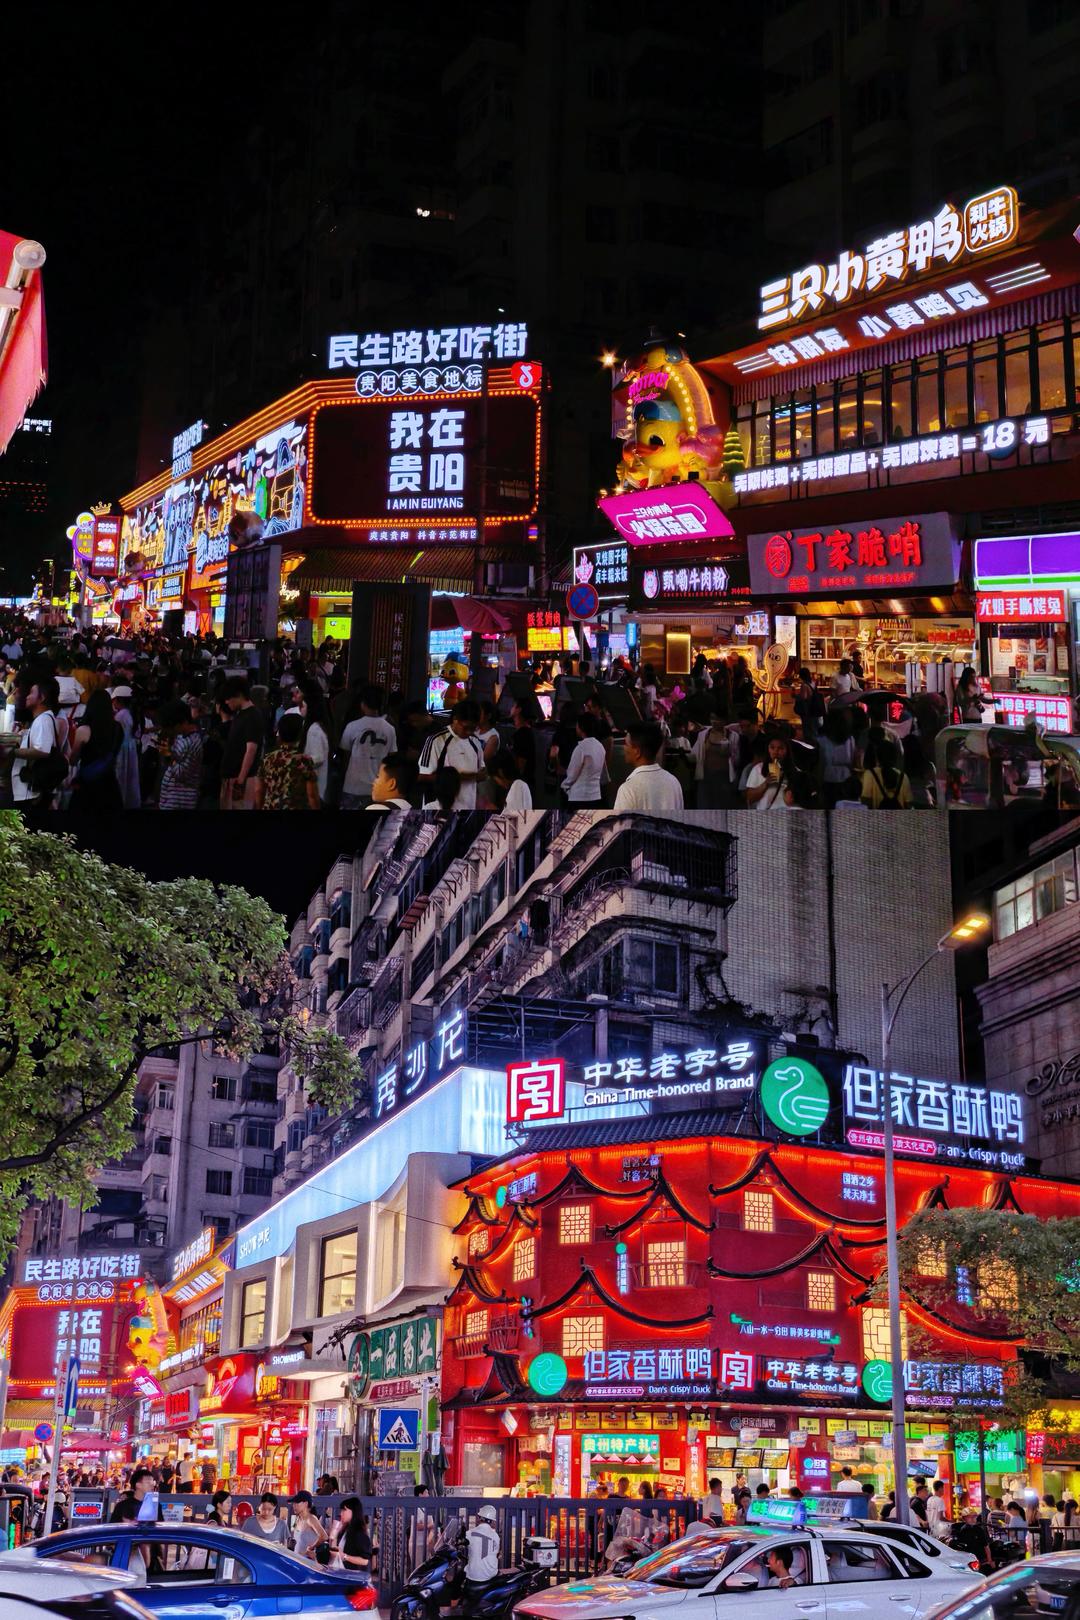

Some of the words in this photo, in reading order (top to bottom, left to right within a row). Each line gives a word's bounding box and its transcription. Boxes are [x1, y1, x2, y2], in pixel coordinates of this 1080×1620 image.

[971, 215, 1008, 246] 火锅
[758, 203, 964, 330] 三只小黄鸭
[328, 323, 527, 369] 民生路好吃街
[359, 369, 482, 394] 贵阳美食地标
[390, 409, 465, 449] 我在
[389, 453, 464, 492] 贵阳
[392, 498, 408, 510] AM
[409, 498, 419, 509] IN
[796, 520, 922, 572] 丁家脆哨
[584, 1042, 754, 1088] 中华老字号
[584, 1091, 618, 1106] China
[624, 1078, 710, 1103] Time-honored
[716, 1074, 754, 1092] Brand
[844, 1065, 1024, 1144] 但家香酥鸭
[968, 1147, 998, 1165] Crispy
[1001, 1151, 1025, 1167] Duck
[25, 1254, 140, 1282] 民生路好吃街
[583, 1348, 712, 1382] 但家香酥鸭
[767, 1360, 858, 1383] 中华老字号
[767, 1379, 788, 1389] China
[838, 1382, 858, 1394] Brand
